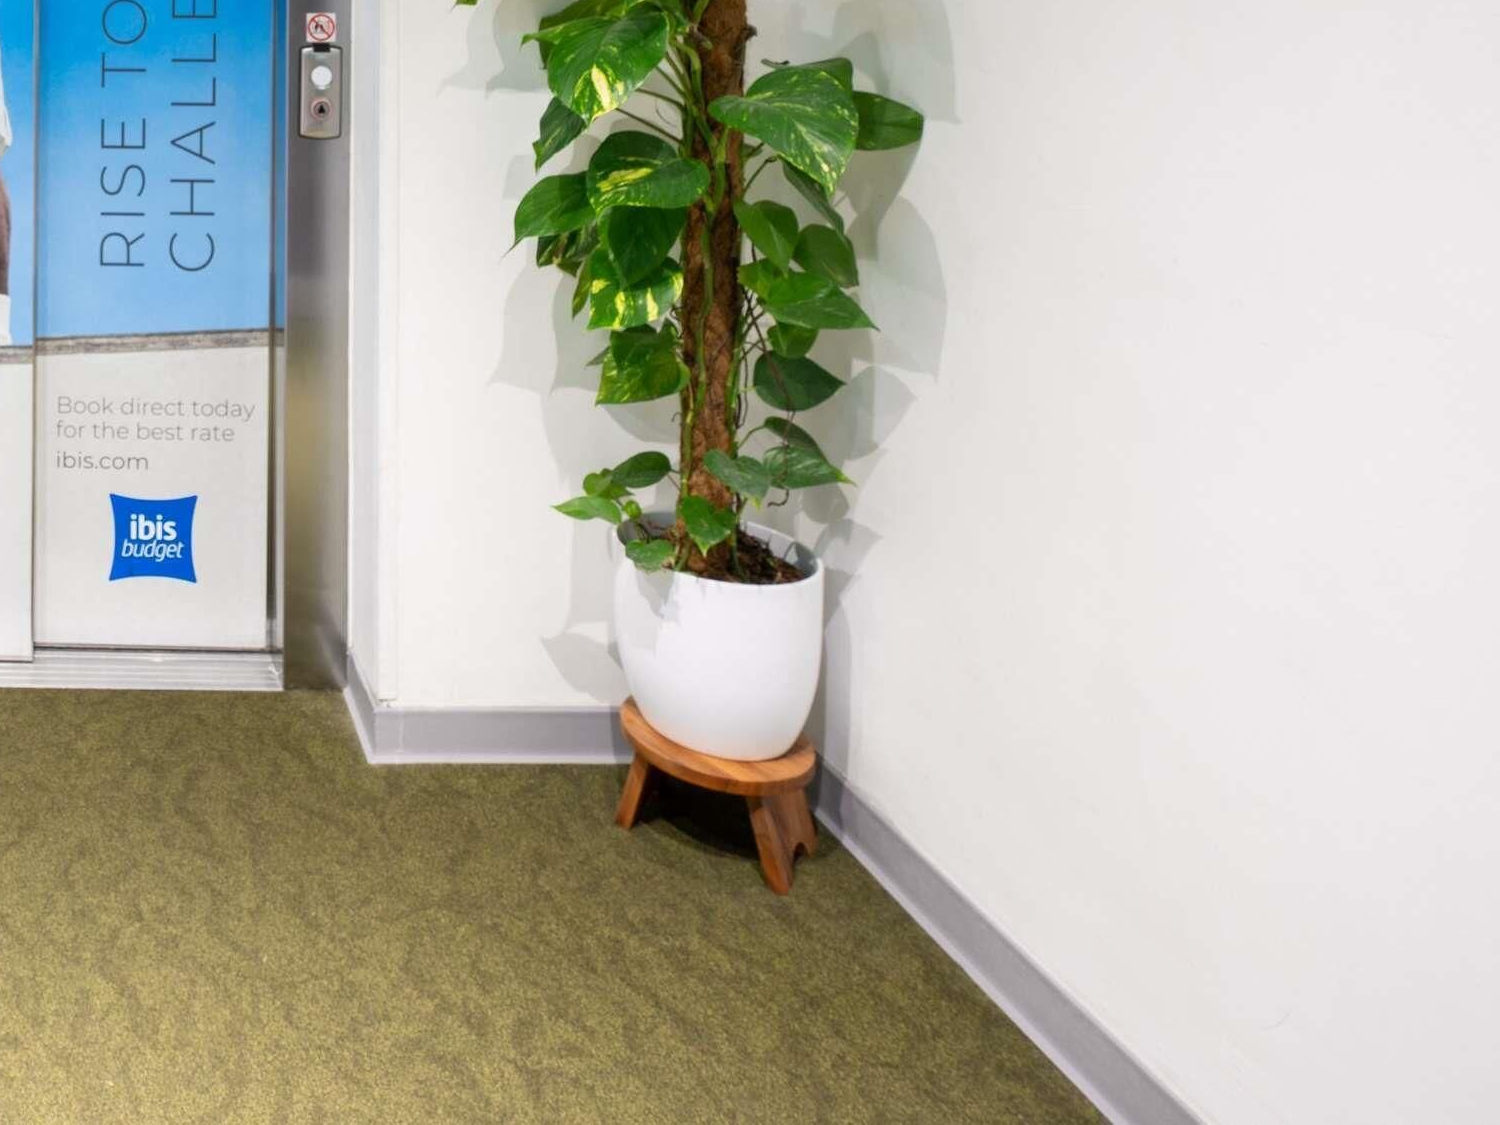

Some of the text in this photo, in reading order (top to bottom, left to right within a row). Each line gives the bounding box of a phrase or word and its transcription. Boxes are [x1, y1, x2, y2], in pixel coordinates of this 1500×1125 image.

[100, 118, 146, 267] RISE
[56, 396, 256, 422] Book direct today
[56, 420, 235, 442] for the best rate
[56, 451, 149, 470] ibis.com
[130, 513, 177, 541] ibis
[121, 539, 185, 562] budget
